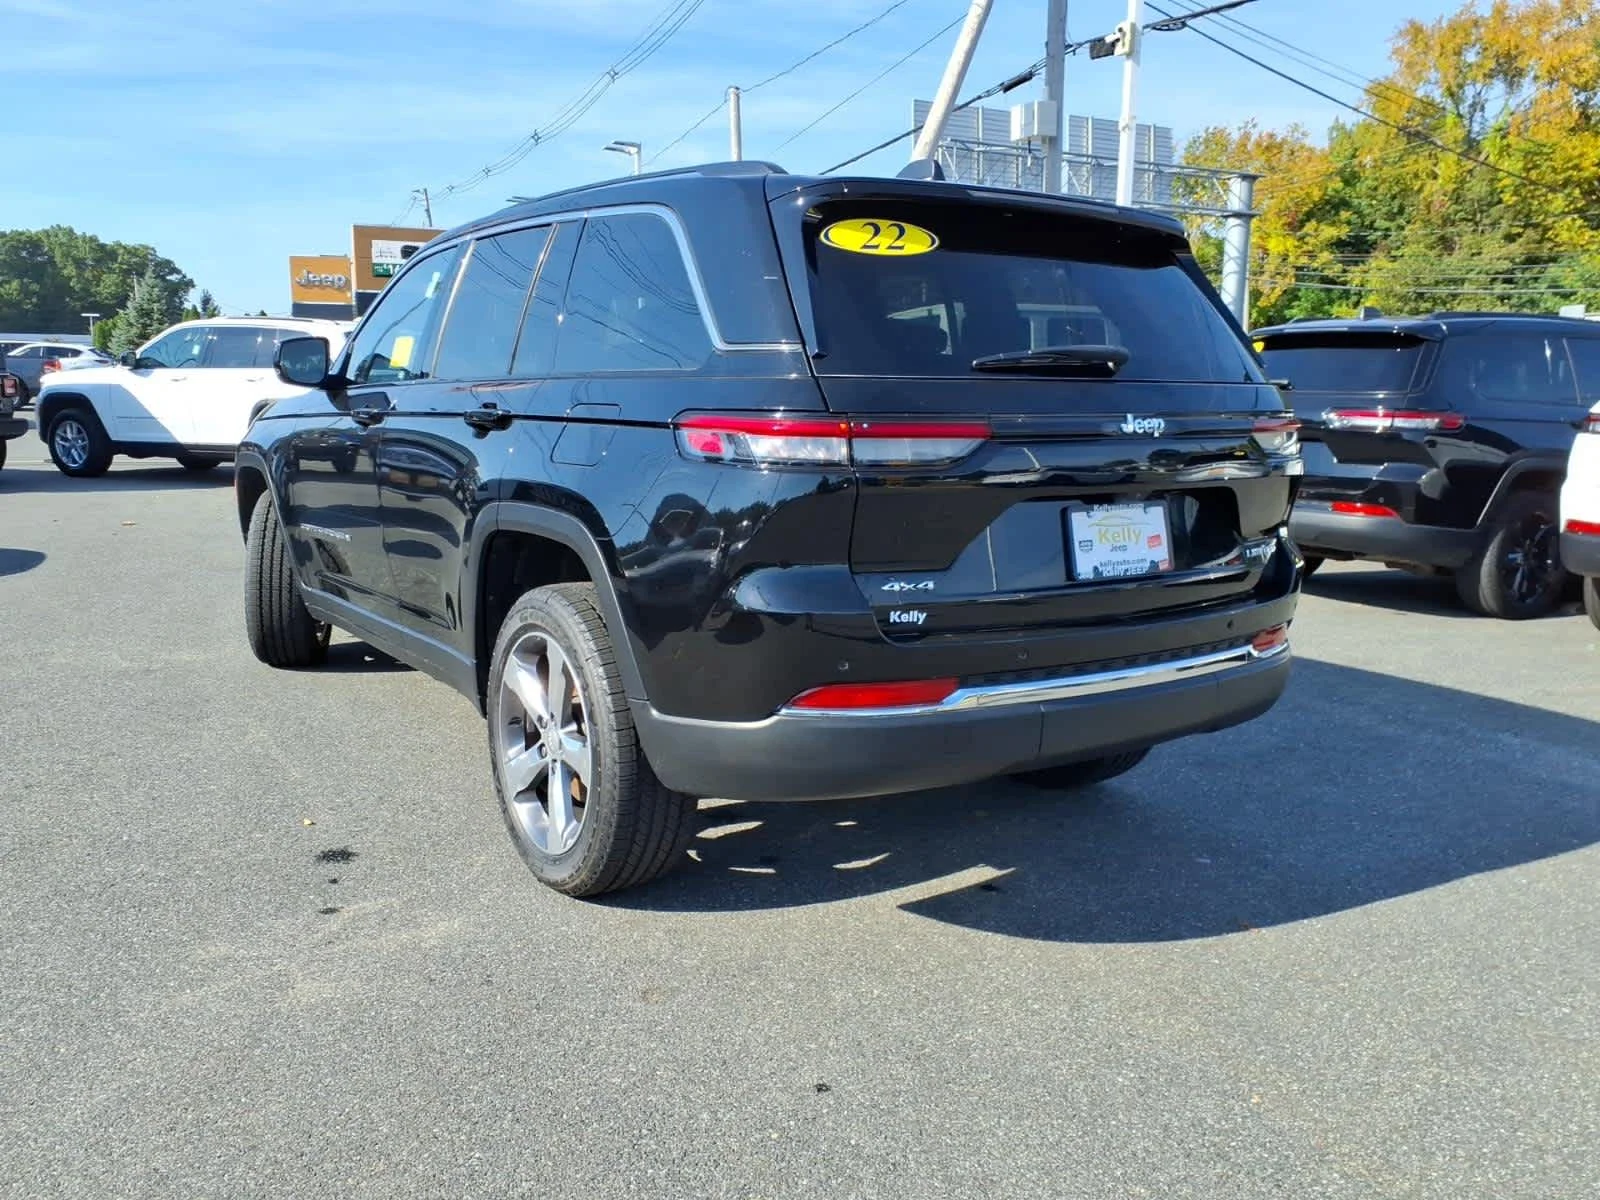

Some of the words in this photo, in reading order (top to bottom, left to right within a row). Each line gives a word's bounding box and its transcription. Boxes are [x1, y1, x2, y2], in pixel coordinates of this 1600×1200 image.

[860, 222, 906, 250] 22
[296, 269, 348, 289] Jeep
[1120, 413, 1165, 437] Jeep
[1098, 527, 1142, 545] Kelly
[1110, 544, 1128, 552] Jeep
[889, 610, 928, 625] Kelly
